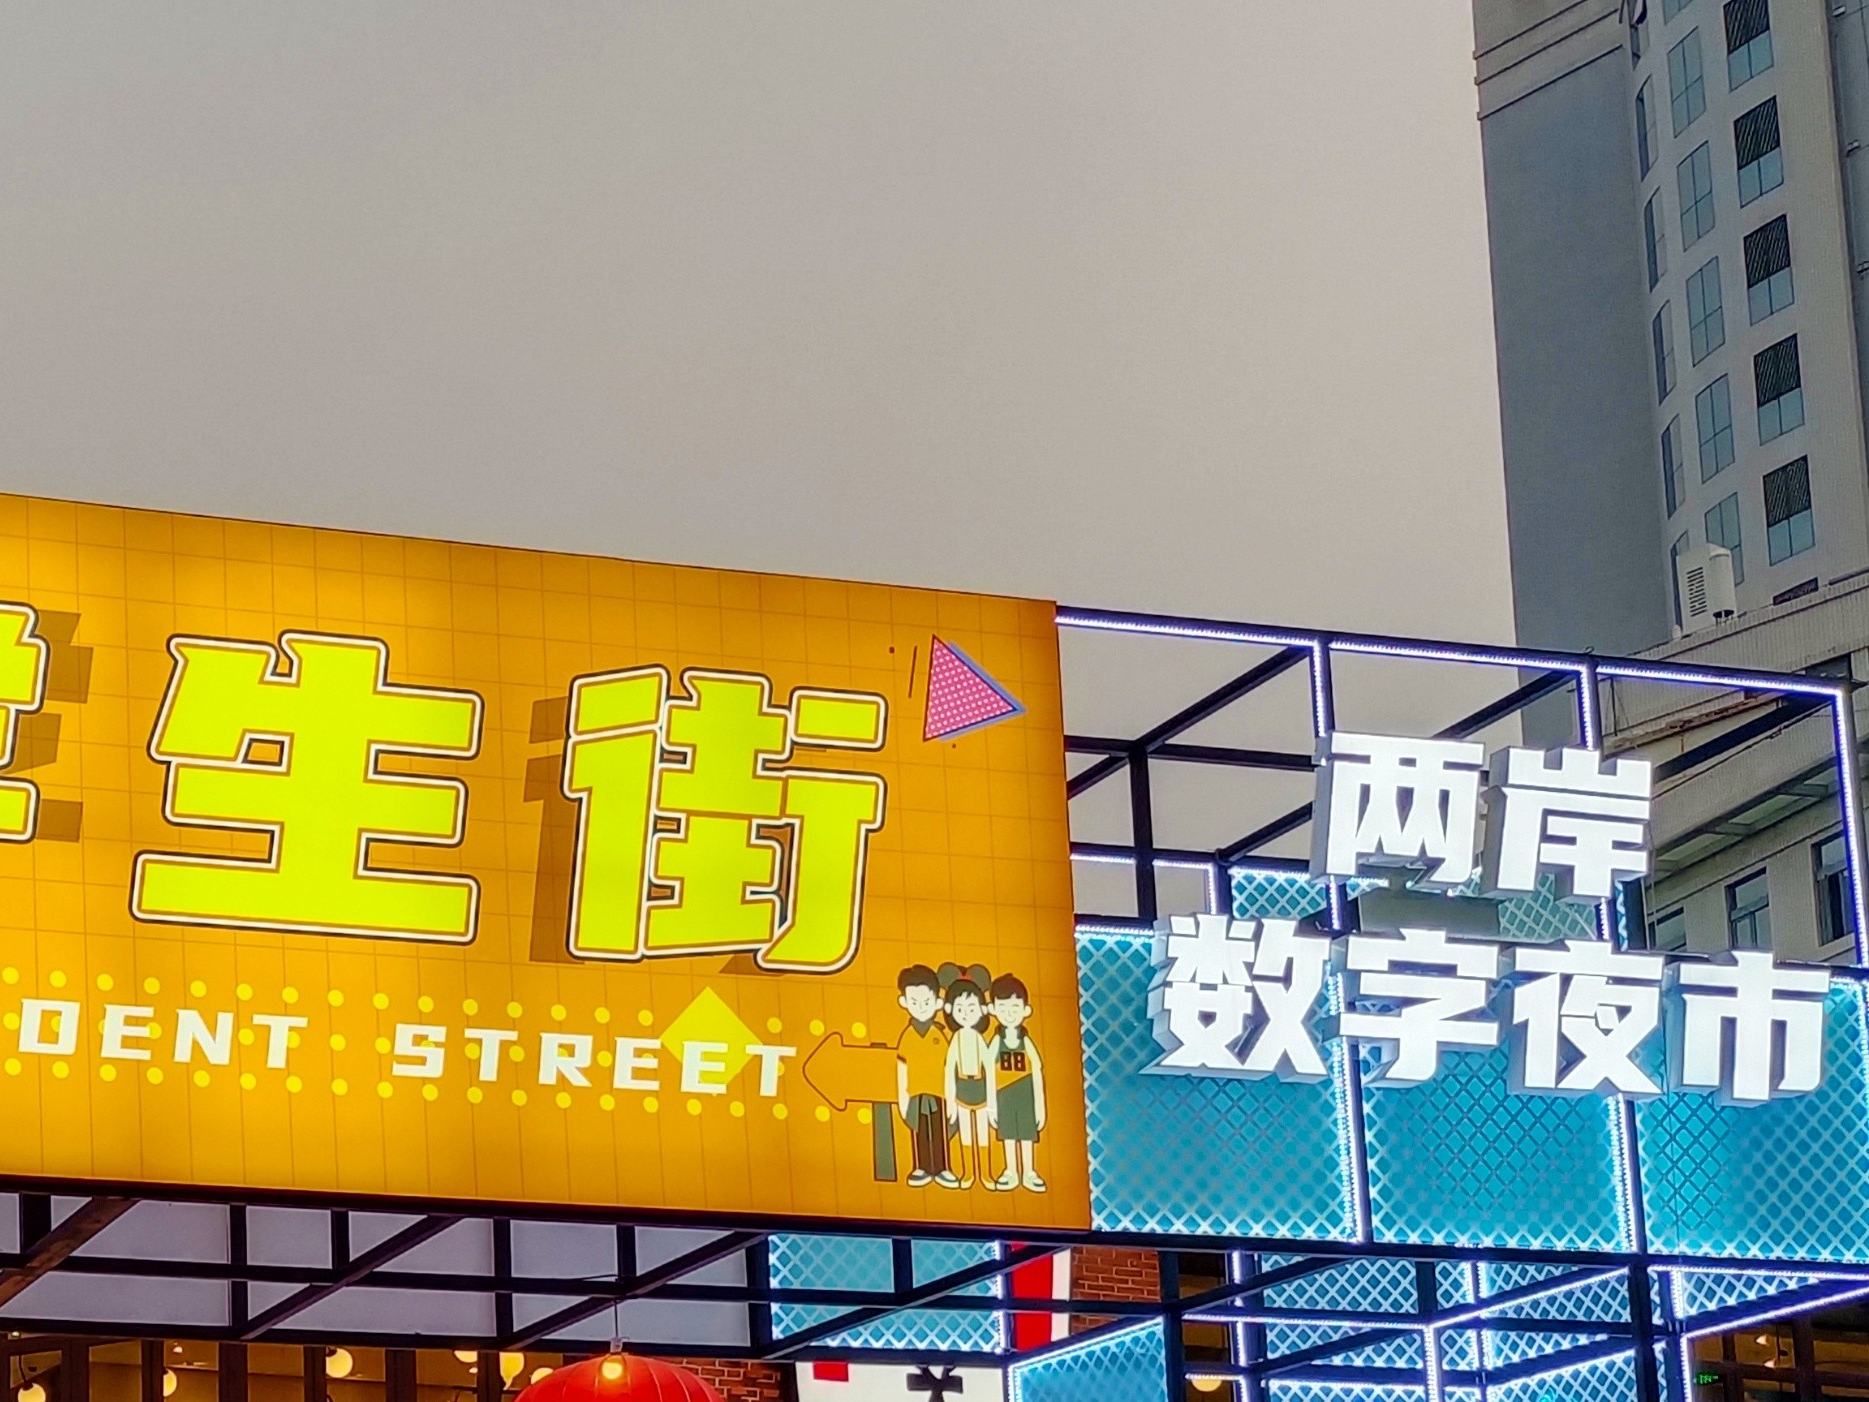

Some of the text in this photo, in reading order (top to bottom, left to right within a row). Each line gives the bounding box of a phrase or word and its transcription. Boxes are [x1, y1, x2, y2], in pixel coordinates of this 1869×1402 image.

[1320, 732, 1652, 900] 两岸
[390, 1025, 799, 1098] STREET
[1148, 912, 1831, 1104] 数字夜市
